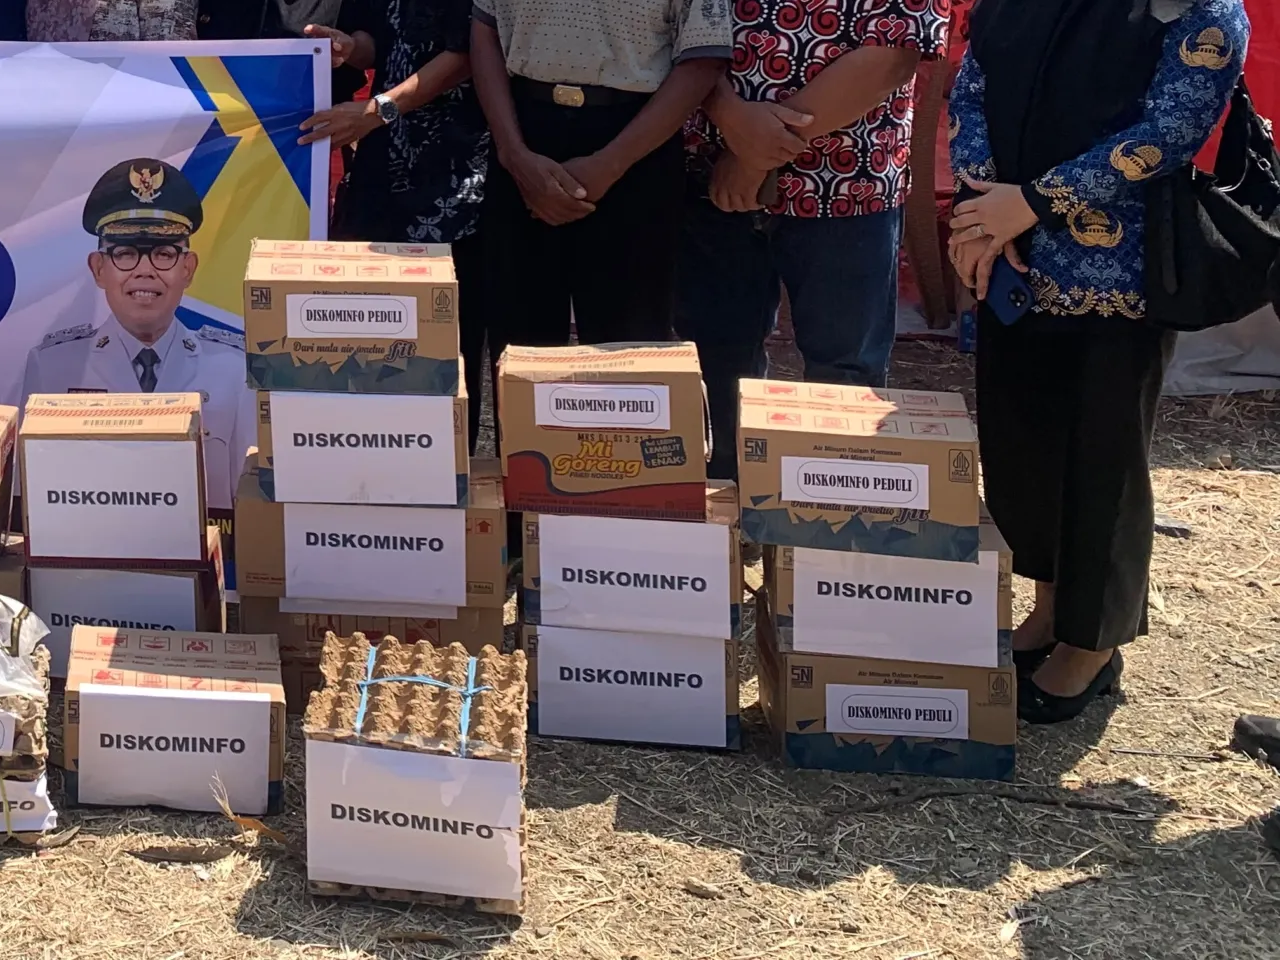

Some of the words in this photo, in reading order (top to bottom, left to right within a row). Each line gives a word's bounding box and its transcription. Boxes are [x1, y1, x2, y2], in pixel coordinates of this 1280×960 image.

[306, 309, 364, 322] DISKOMINFO
[368, 311, 402, 322] PEDULI
[293, 341, 314, 352] Dari
[555, 398, 615, 411] DISKOMINFO
[619, 401, 654, 412] PEDULI
[293, 433, 432, 448] DISKOMINFO
[578, 440, 613, 458] Mi
[552, 454, 642, 478] Goreng
[651, 456, 681, 466] ENAK
[804, 473, 869, 489] DISKOMINFO
[874, 478, 911, 491] PEDULI
[48, 491, 178, 506] DISKOMINFO
[306, 532, 443, 551] DISKOMINFO
[562, 568, 706, 592] DISKOMINFO
[818, 581, 972, 605] DISKOMINFO
[560, 667, 702, 688] DISKOMINFO
[848, 706, 911, 720] DISKOMINFO
[915, 709, 952, 722] PEDULI
[100, 734, 245, 753] DISKOMINFO
[331, 804, 494, 839] DISKOMINFO
